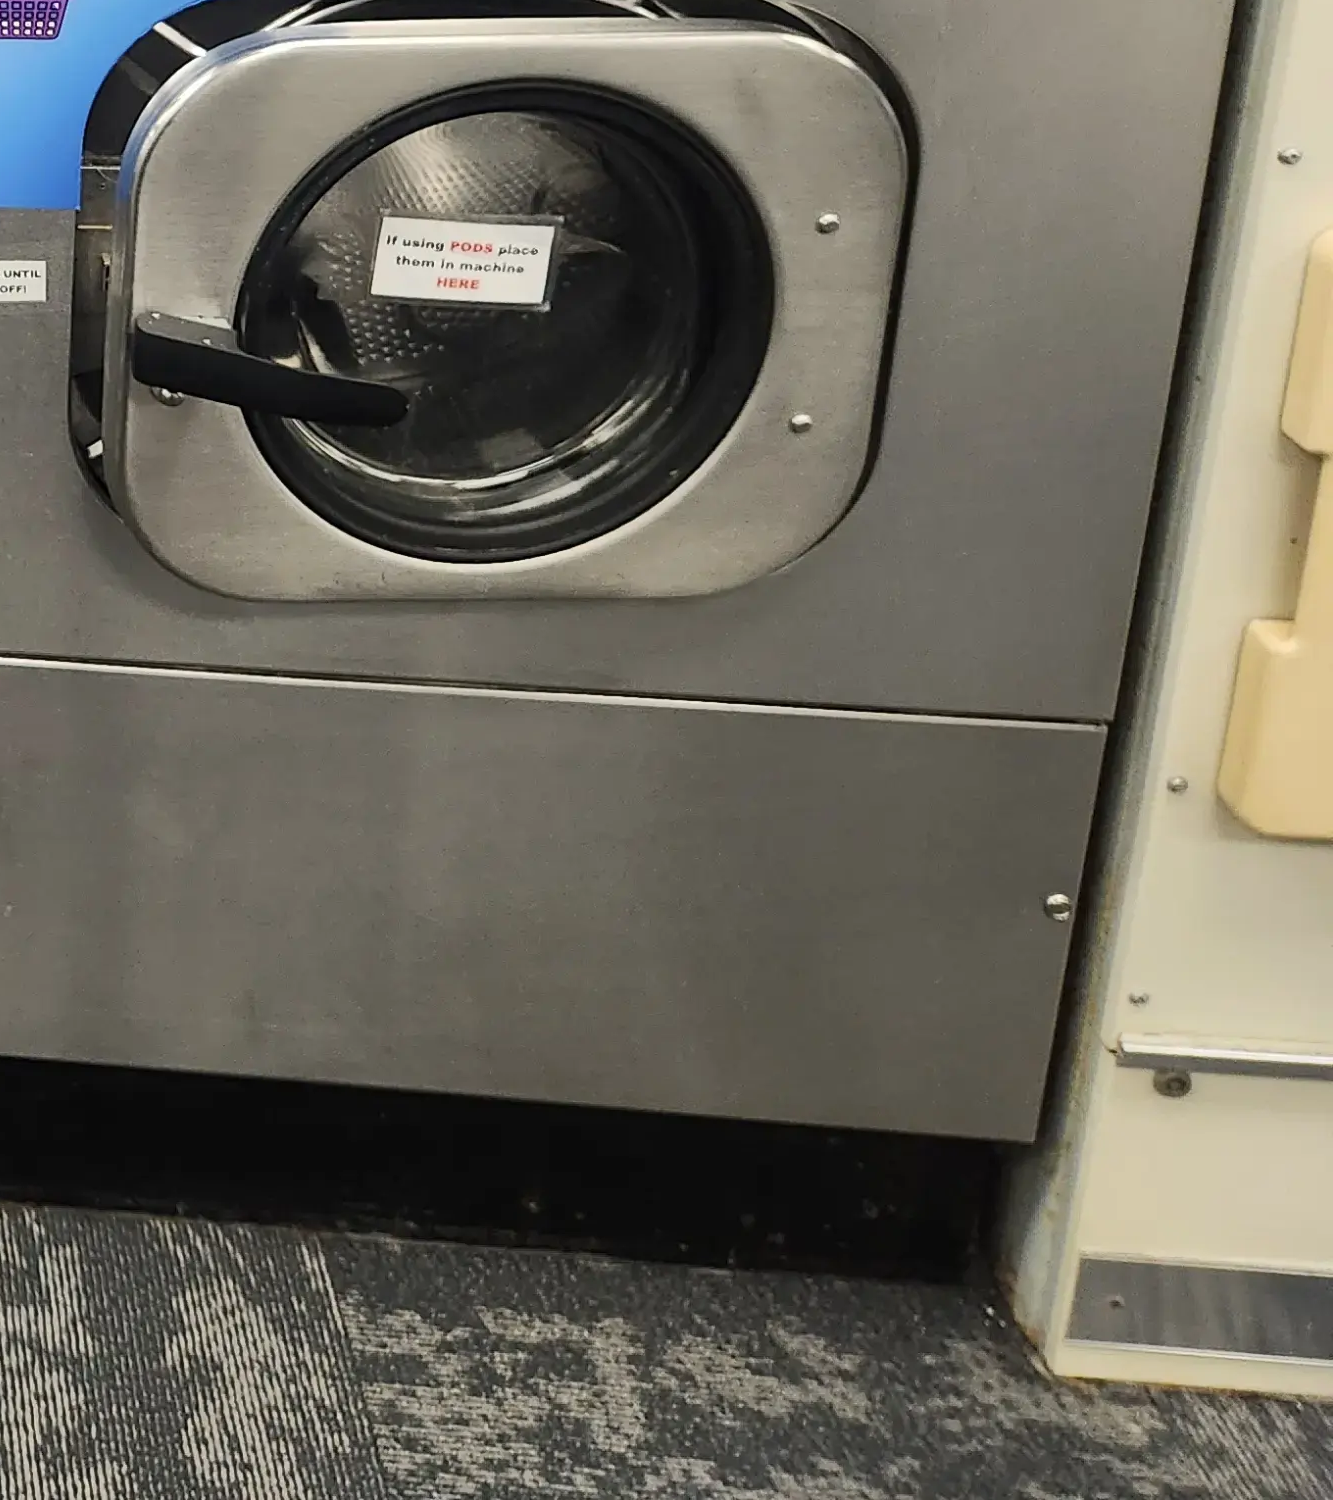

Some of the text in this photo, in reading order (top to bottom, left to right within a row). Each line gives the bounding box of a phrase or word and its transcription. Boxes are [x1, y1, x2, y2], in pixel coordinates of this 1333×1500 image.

[386, 235, 539, 256] If using PODS place
[396, 256, 525, 274] them in machine
[4, 269, 41, 278] UNTIL
[437, 277, 481, 289] HERE
